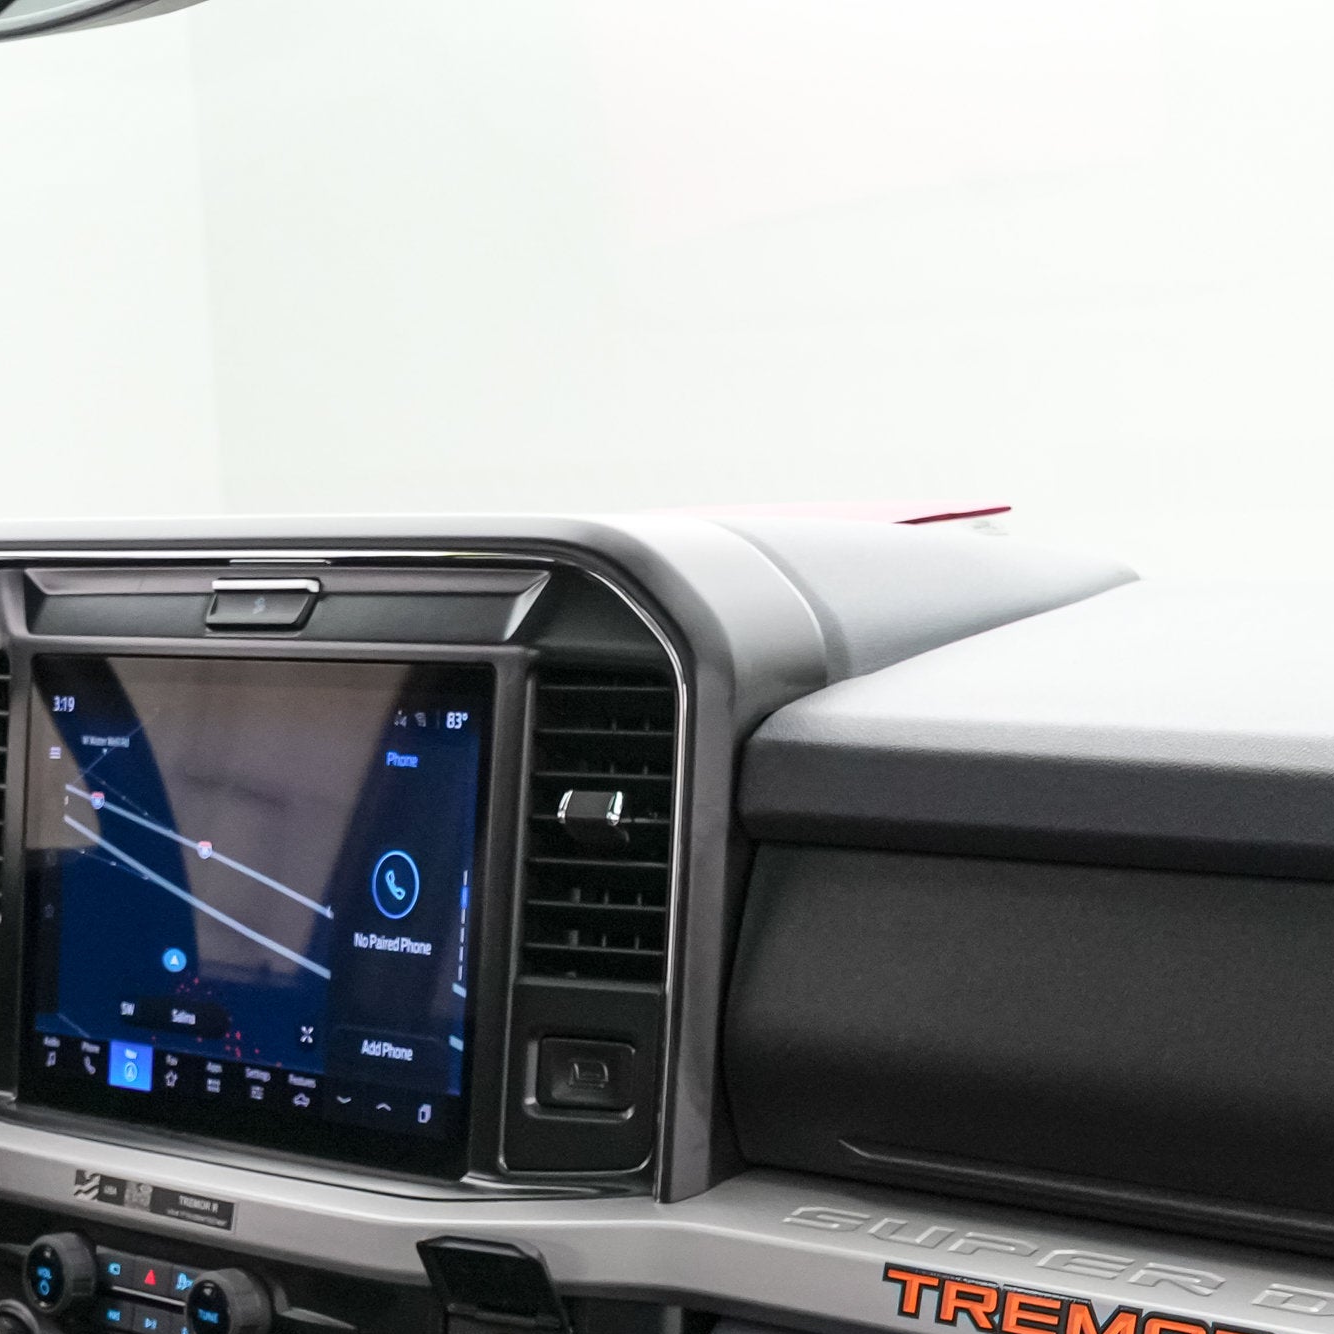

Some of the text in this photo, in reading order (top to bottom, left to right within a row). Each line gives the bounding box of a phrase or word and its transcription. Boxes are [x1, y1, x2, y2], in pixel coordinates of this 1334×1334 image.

[52, 695, 76, 713] 3:19
[385, 751, 419, 768] Phone
[353, 932, 432, 956] No Paired Phone
[361, 1039, 414, 1062] Add Phone
[782, 1205, 1227, 1297] SUPER
